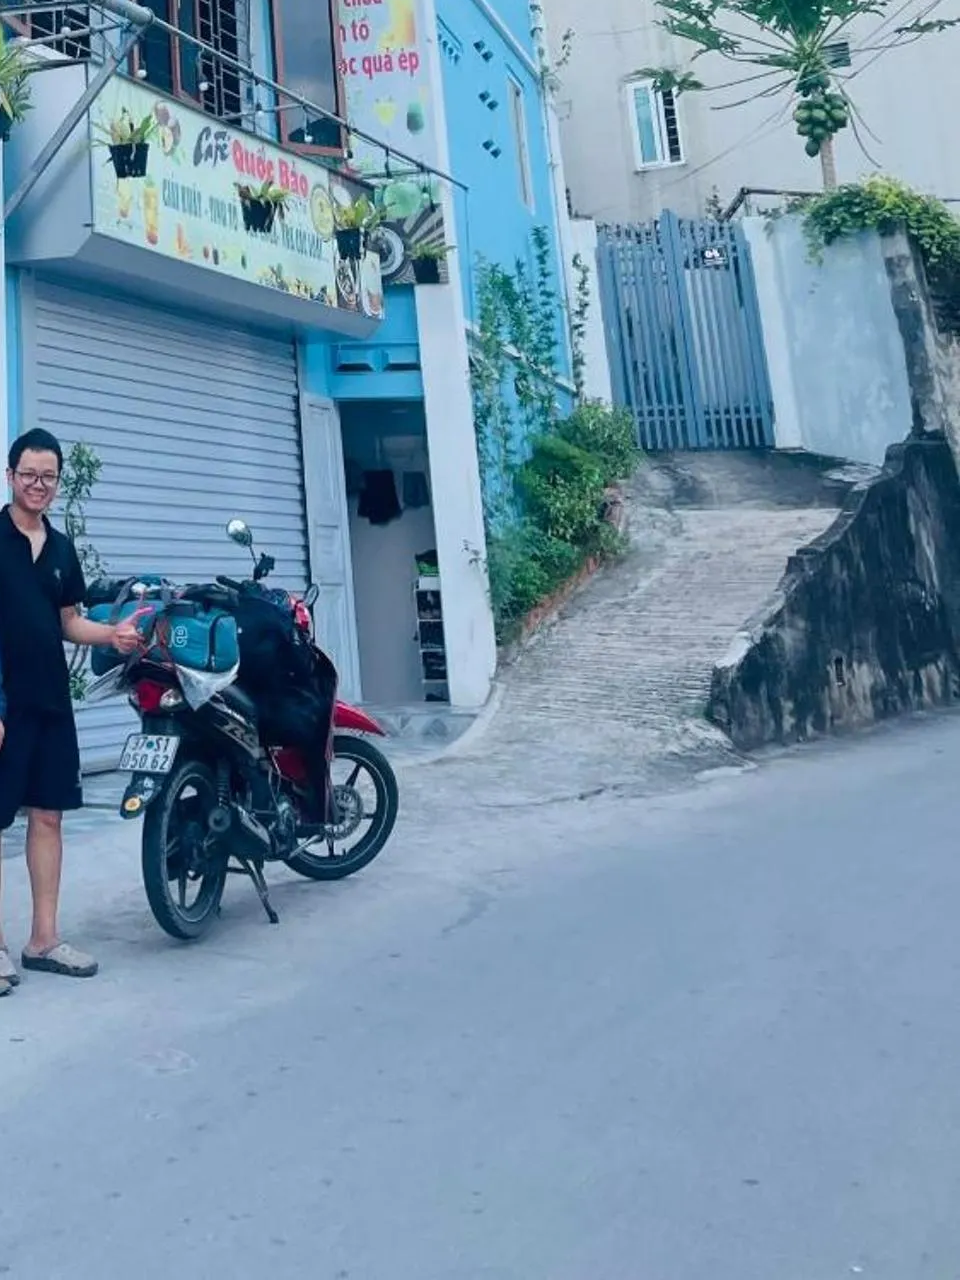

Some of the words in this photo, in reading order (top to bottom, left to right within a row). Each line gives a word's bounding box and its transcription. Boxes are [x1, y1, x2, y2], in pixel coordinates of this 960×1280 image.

[352, 14, 369, 42] tố
[362, 47, 393, 80] quả
[398, 48, 420, 77] ép
